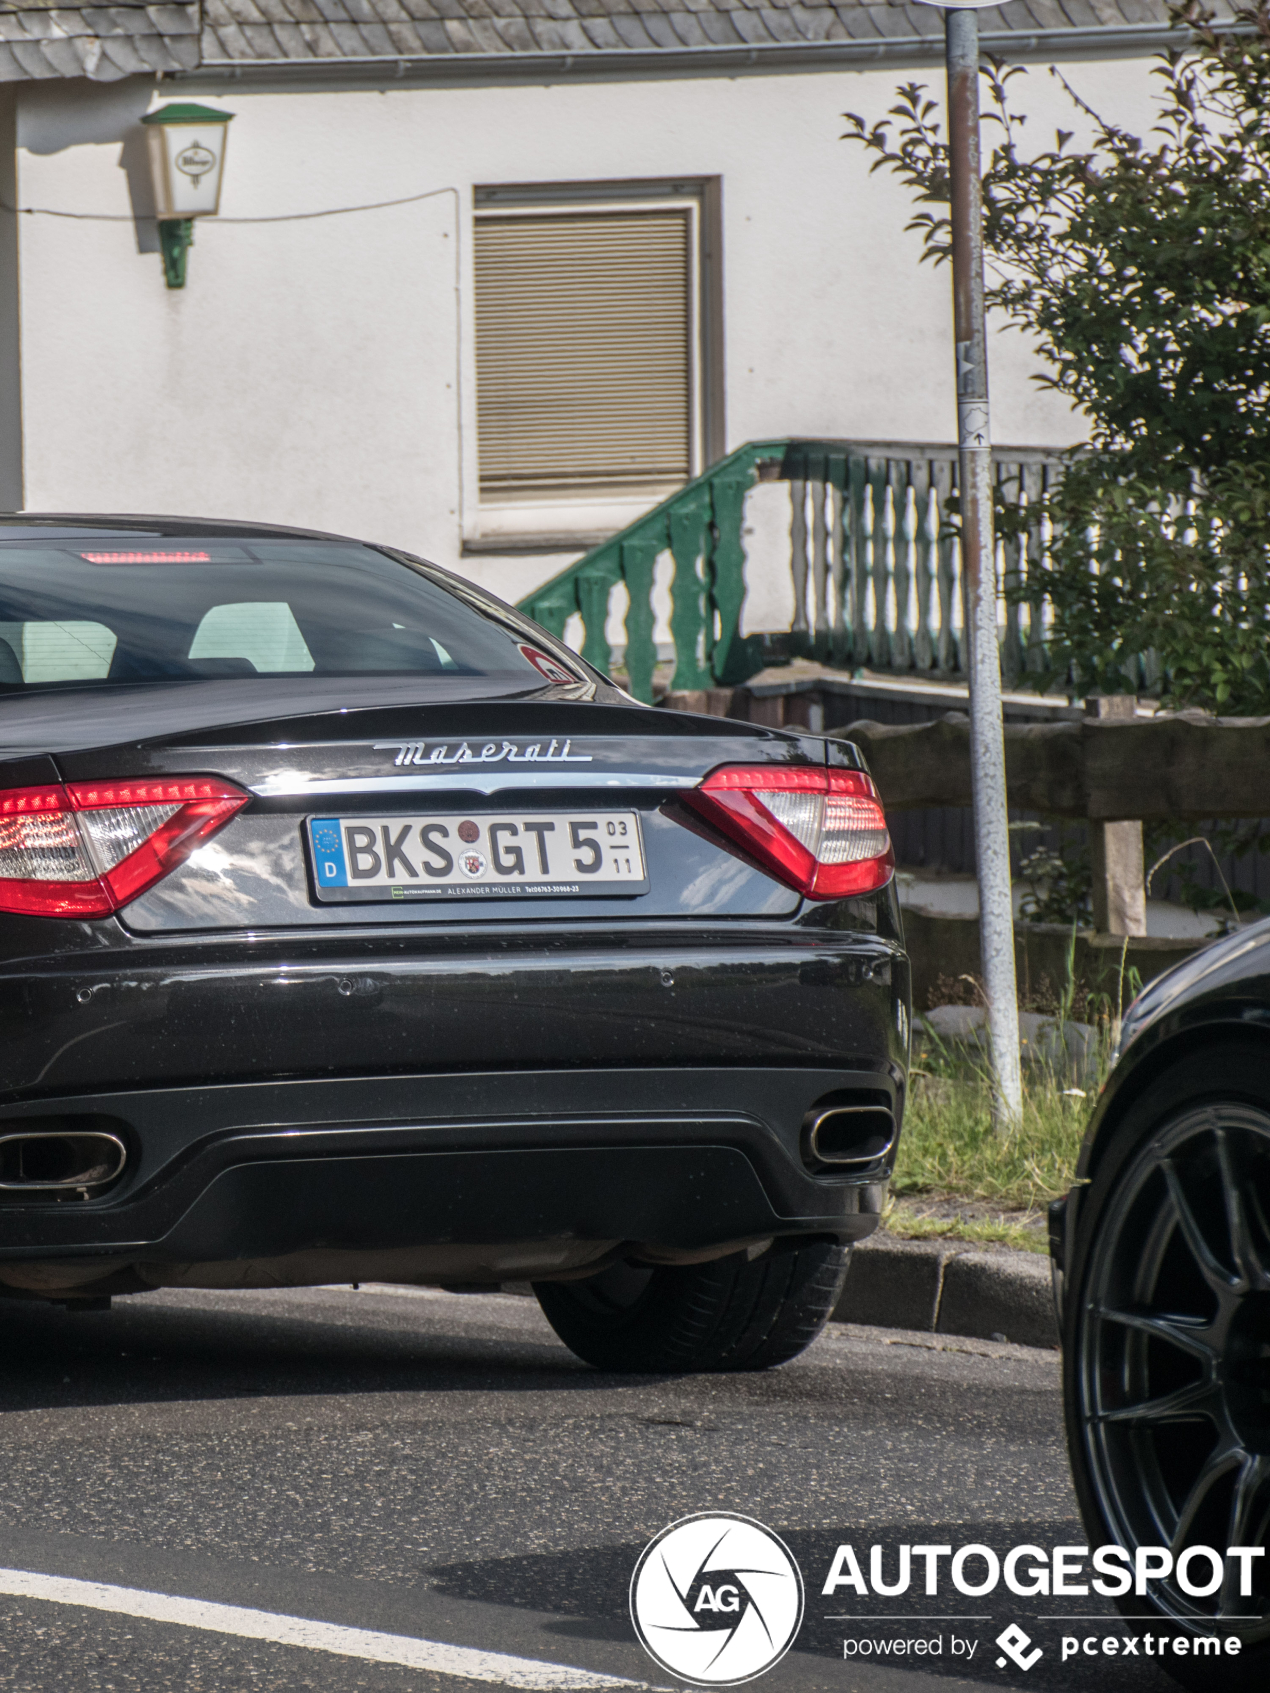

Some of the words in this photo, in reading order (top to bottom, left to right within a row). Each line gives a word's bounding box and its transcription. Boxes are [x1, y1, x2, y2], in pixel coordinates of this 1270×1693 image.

[373, 739, 593, 766] Maserati
[344, 823, 455, 880] BKS
[488, 821, 555, 876] GT
[568, 821, 603, 874] 5
[606, 821, 628, 836] 03
[325, 862, 337, 878] D
[613, 858, 632, 874] 11
[492, 885, 522, 894] MÜLLER
